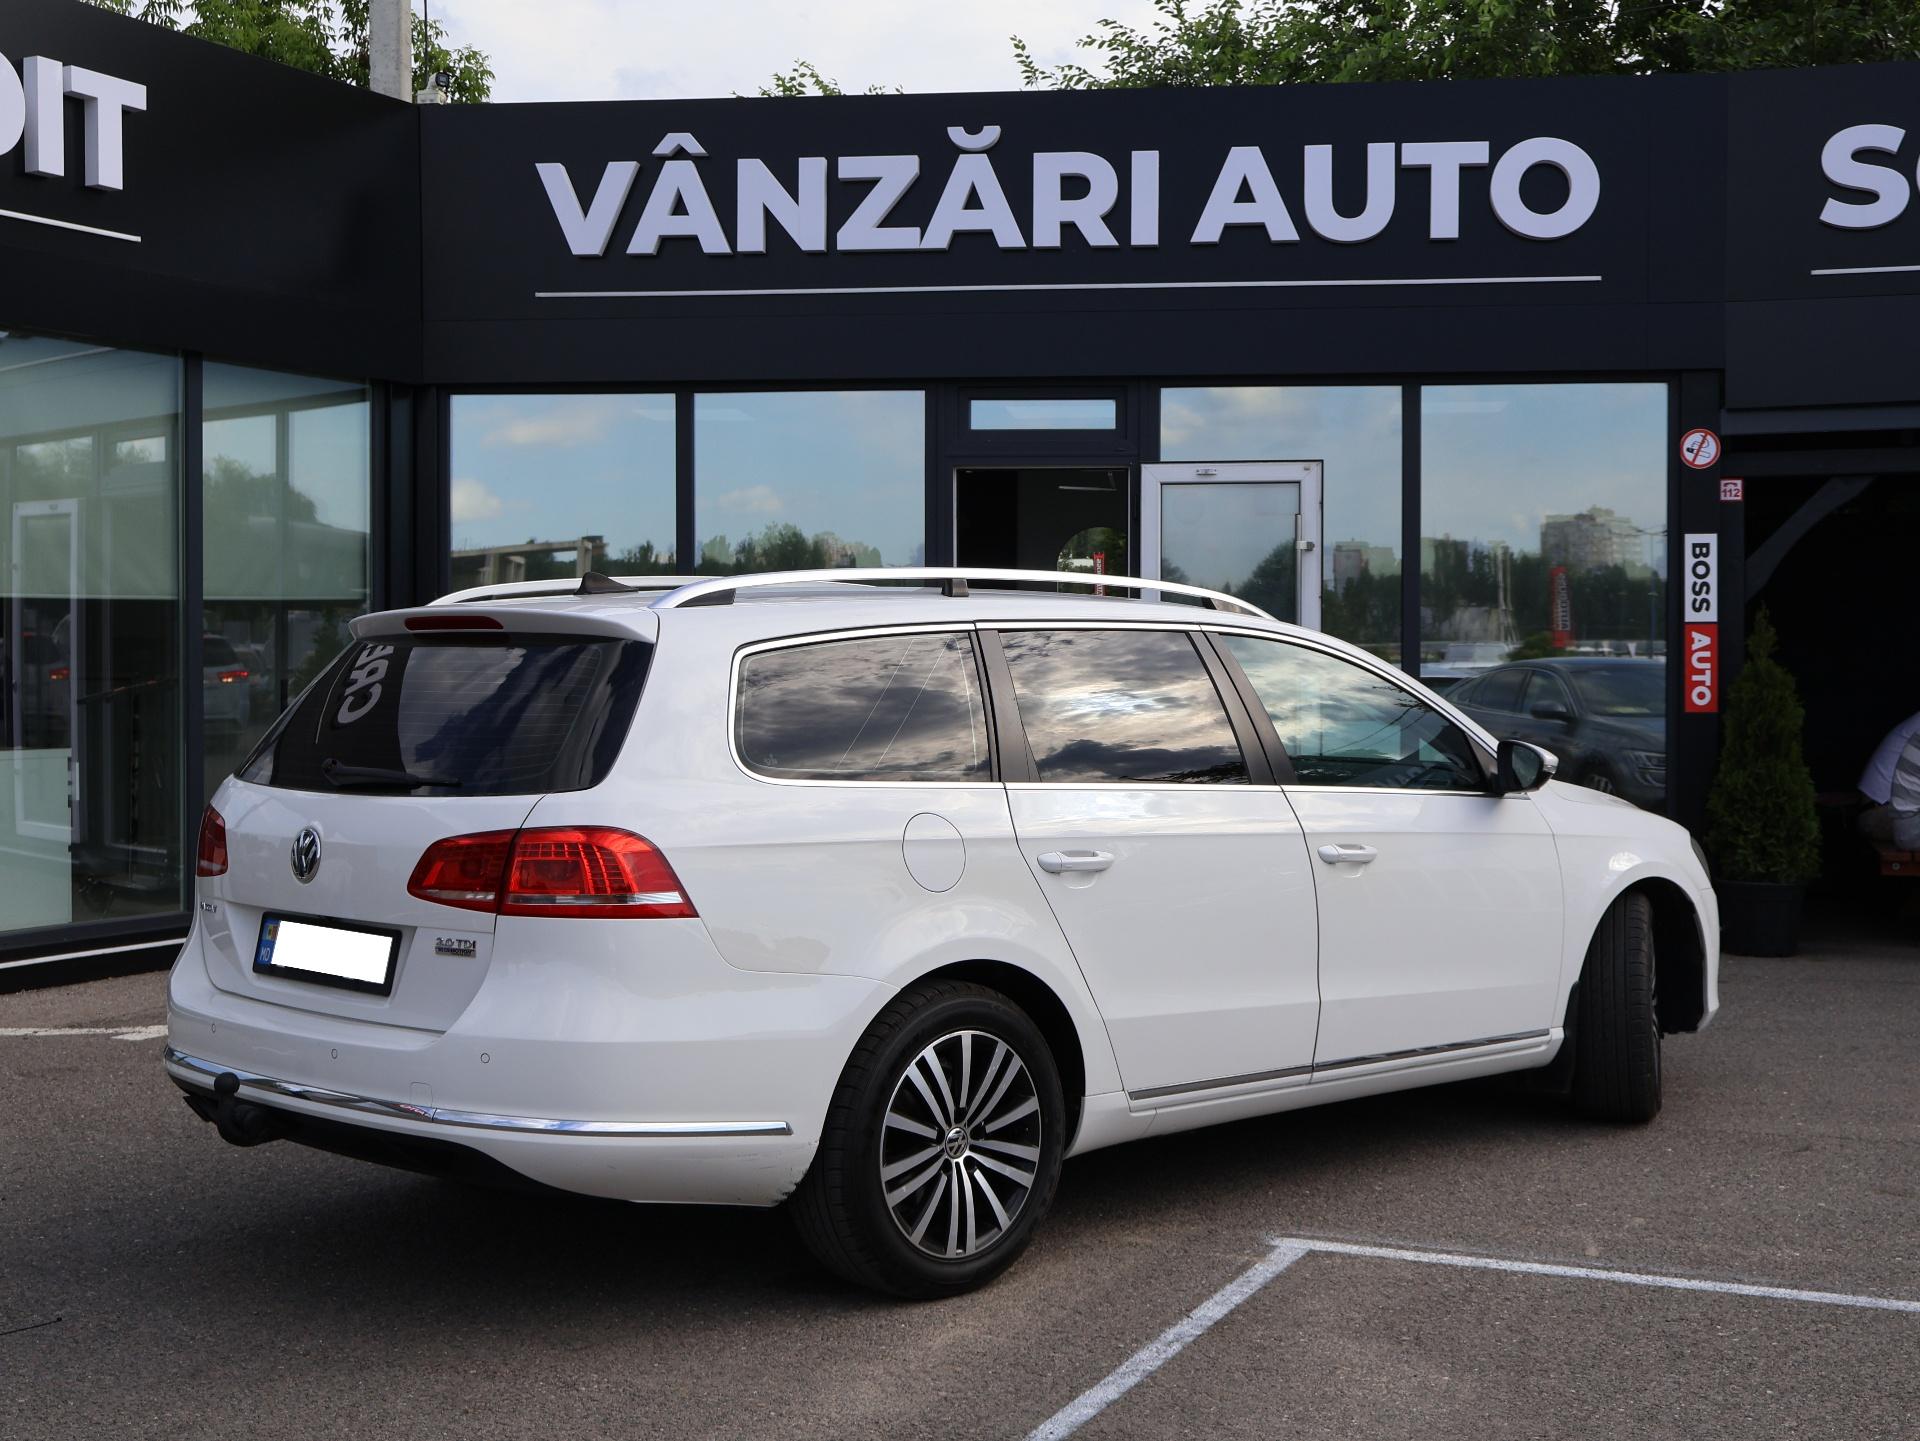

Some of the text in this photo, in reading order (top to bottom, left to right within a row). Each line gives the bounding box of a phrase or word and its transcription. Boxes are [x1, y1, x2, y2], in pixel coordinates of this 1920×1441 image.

[534, 125, 1601, 256] VÂNZĂRI AUTO
[1819, 124, 1920, 229] S
[1721, 488, 1741, 498] 112
[1691, 542, 1712, 706] BOSS AUTO
[260, 947, 271, 962] MD
[455, 938, 477, 950] TDI
